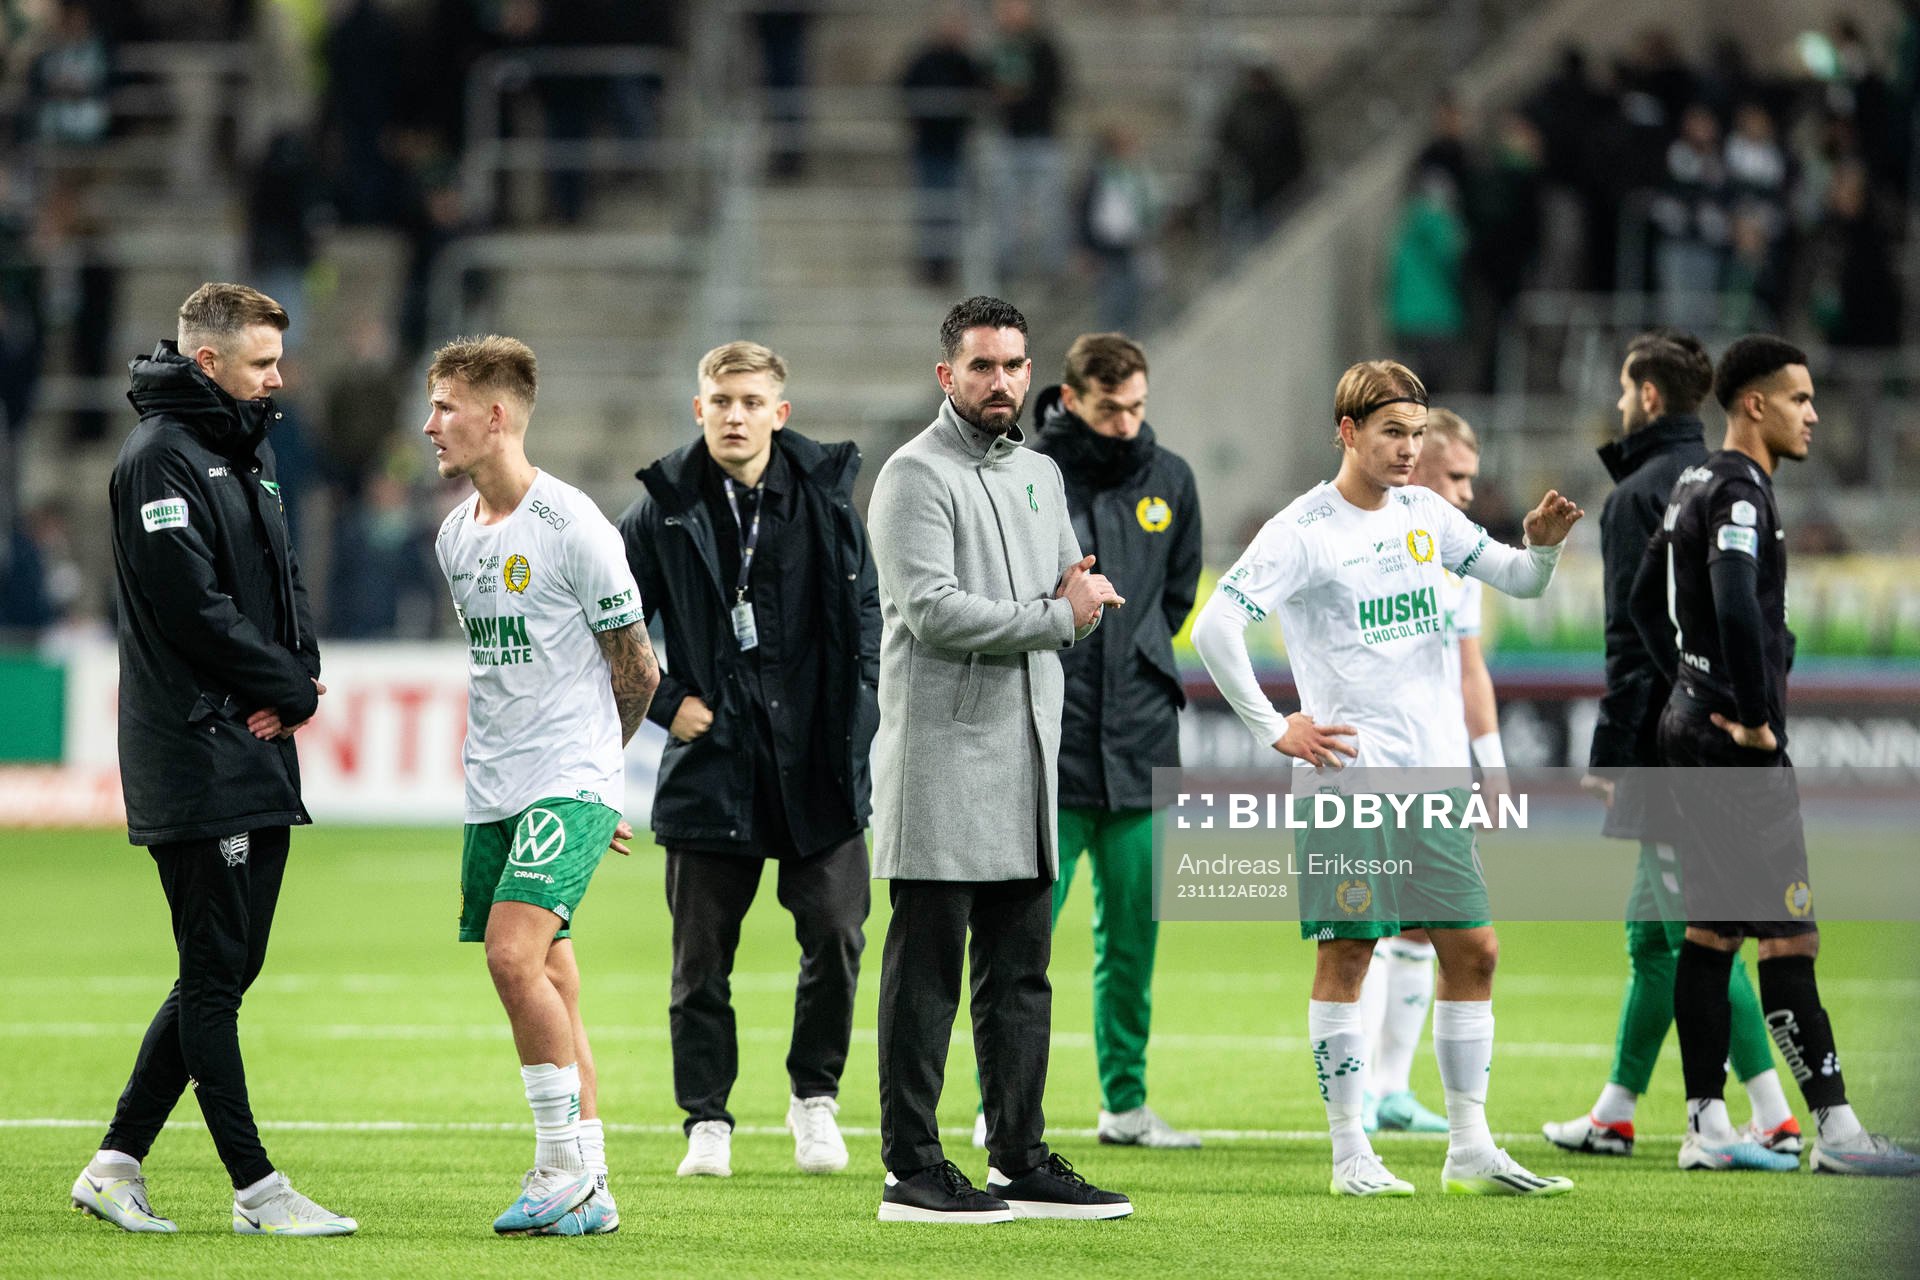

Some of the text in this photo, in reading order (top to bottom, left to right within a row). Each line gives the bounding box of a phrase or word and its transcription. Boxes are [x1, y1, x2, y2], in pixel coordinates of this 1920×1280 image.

[145, 505, 186, 520] UNIBET
[528, 499, 572, 534] sesol
[597, 588, 633, 611] BST
[1359, 586, 1438, 630] HUSKI
[1363, 617, 1440, 645] CHOCOLATE
[514, 871, 546, 884] CRAFT
[1766, 1009, 1813, 1083] Clinton
